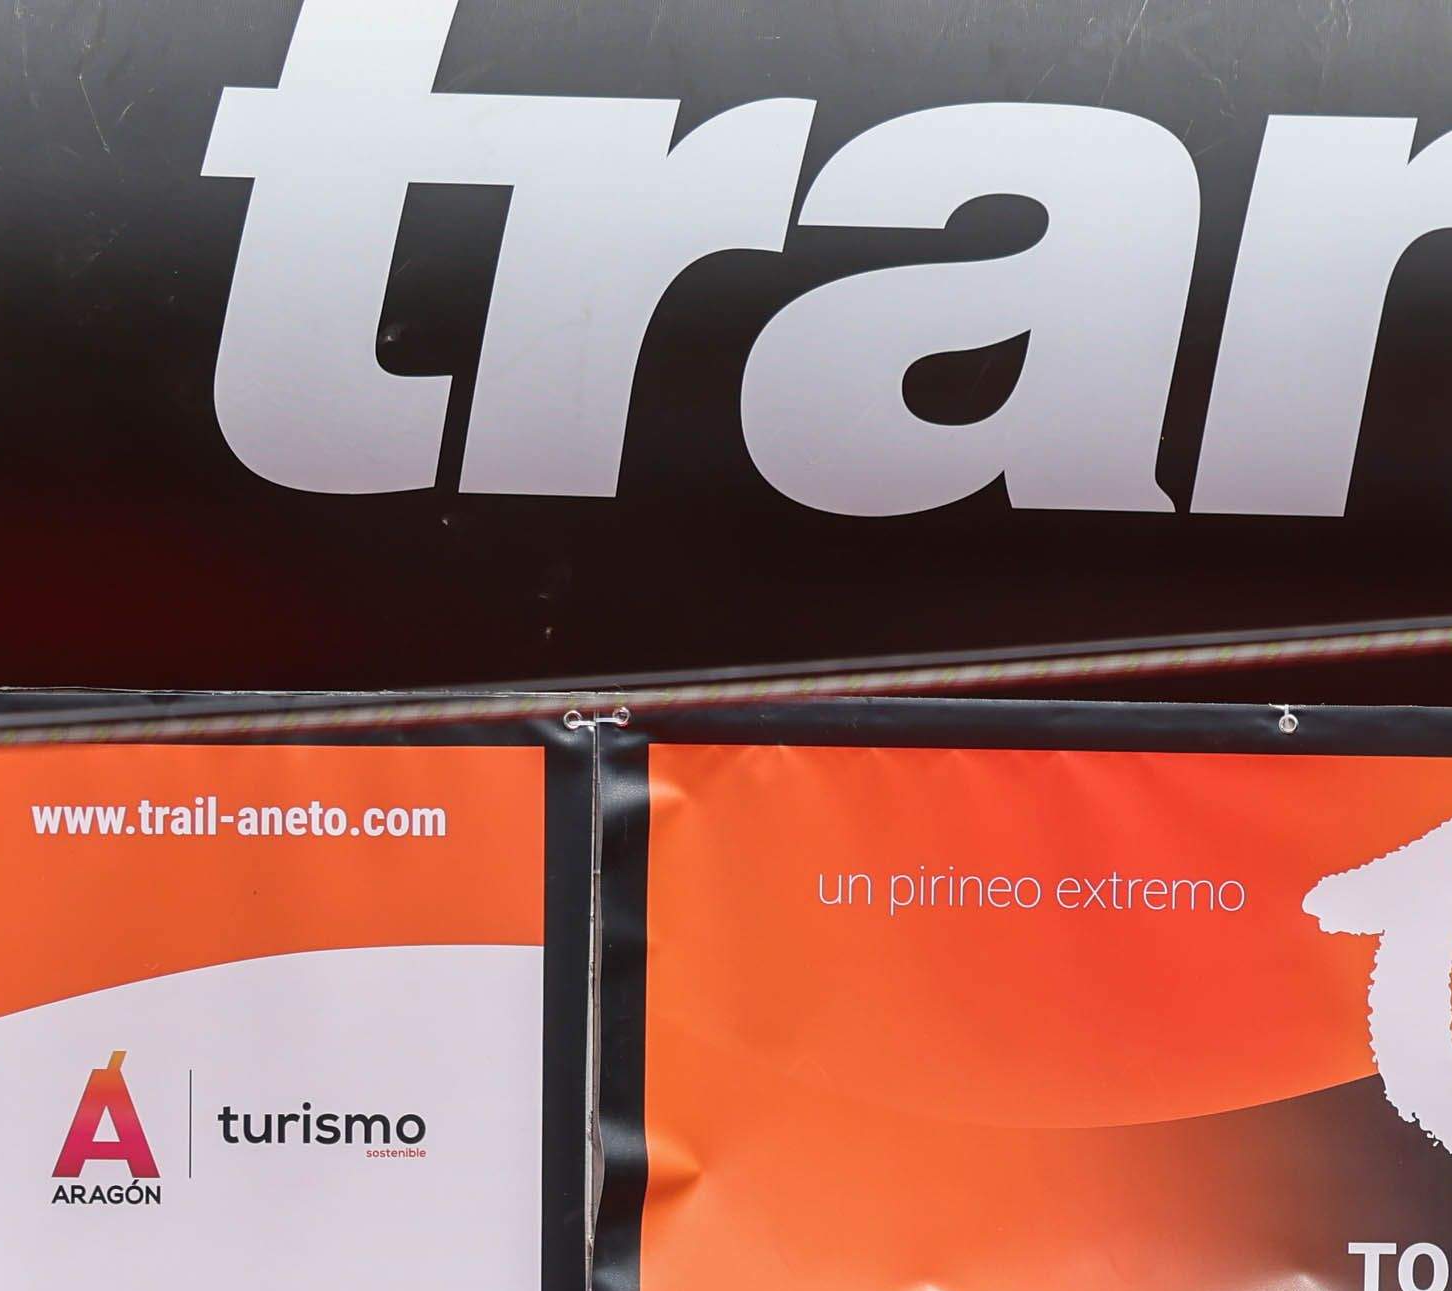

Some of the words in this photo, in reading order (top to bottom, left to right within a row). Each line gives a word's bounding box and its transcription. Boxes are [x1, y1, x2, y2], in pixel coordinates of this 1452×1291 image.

[31, 796, 446, 838] www.trail-aneto.com
[817, 872, 873, 906] un
[890, 865, 1042, 916] pirineo
[1055, 870, 1246, 912] extremo
[217, 1102, 427, 1147] turismo
[365, 1147, 428, 1160] sostenible
[50, 1179, 163, 1206] ARAGÓN
